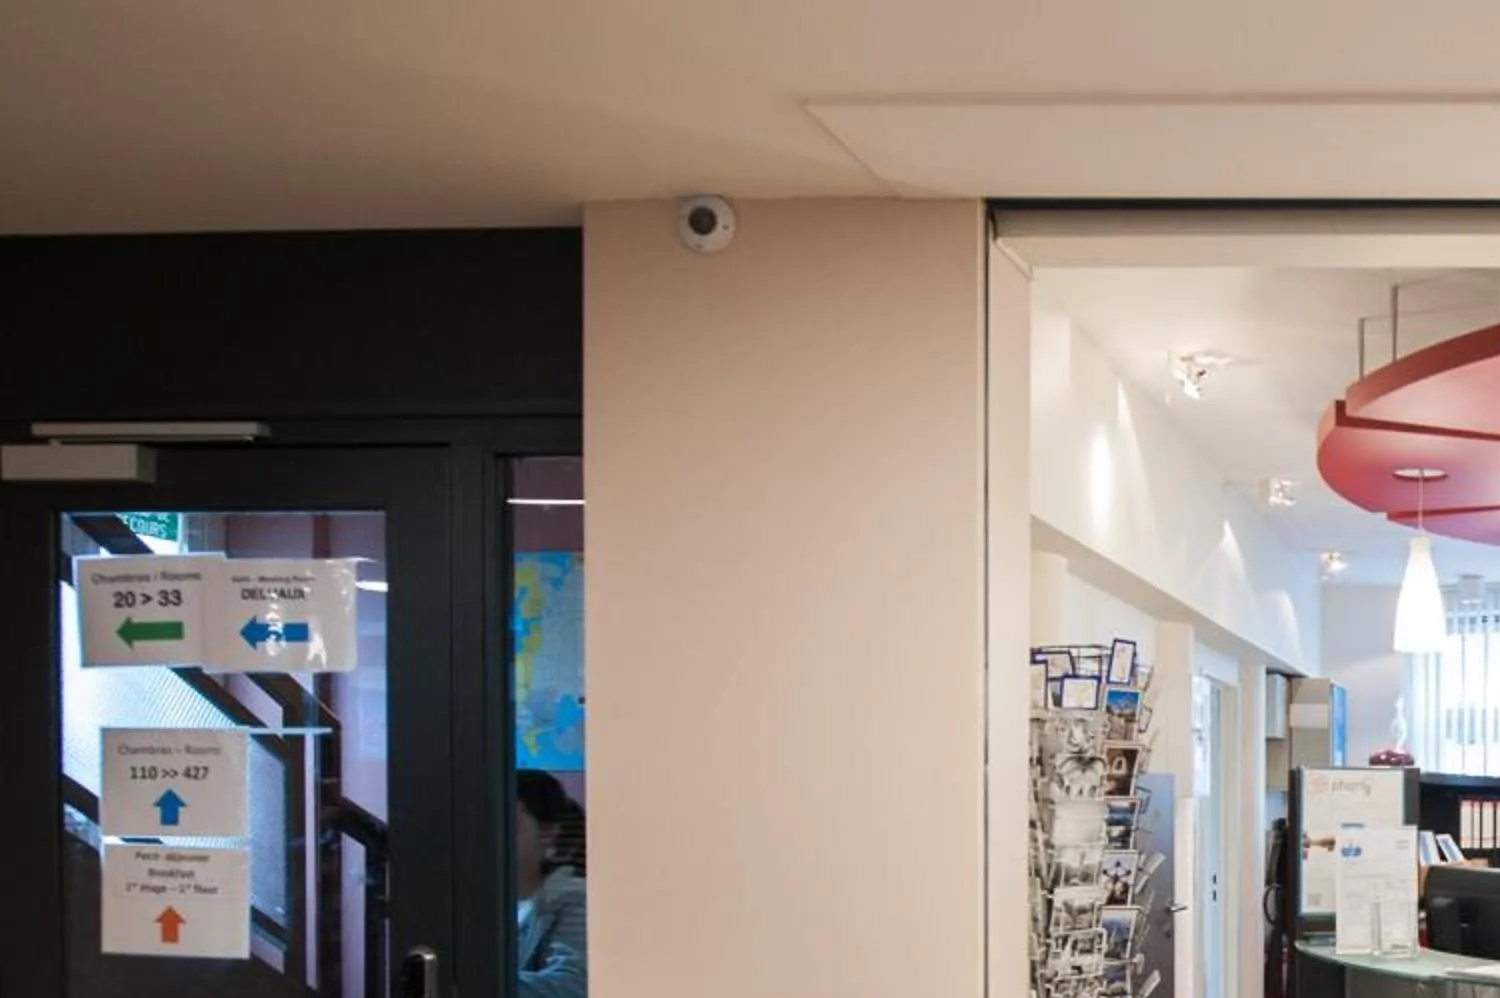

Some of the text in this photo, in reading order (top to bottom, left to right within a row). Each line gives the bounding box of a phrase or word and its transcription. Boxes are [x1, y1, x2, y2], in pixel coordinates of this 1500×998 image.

[113, 590, 137, 609] 20
[157, 589, 183, 608] 33
[130, 765, 158, 780] 110
[183, 765, 210, 780] 427
